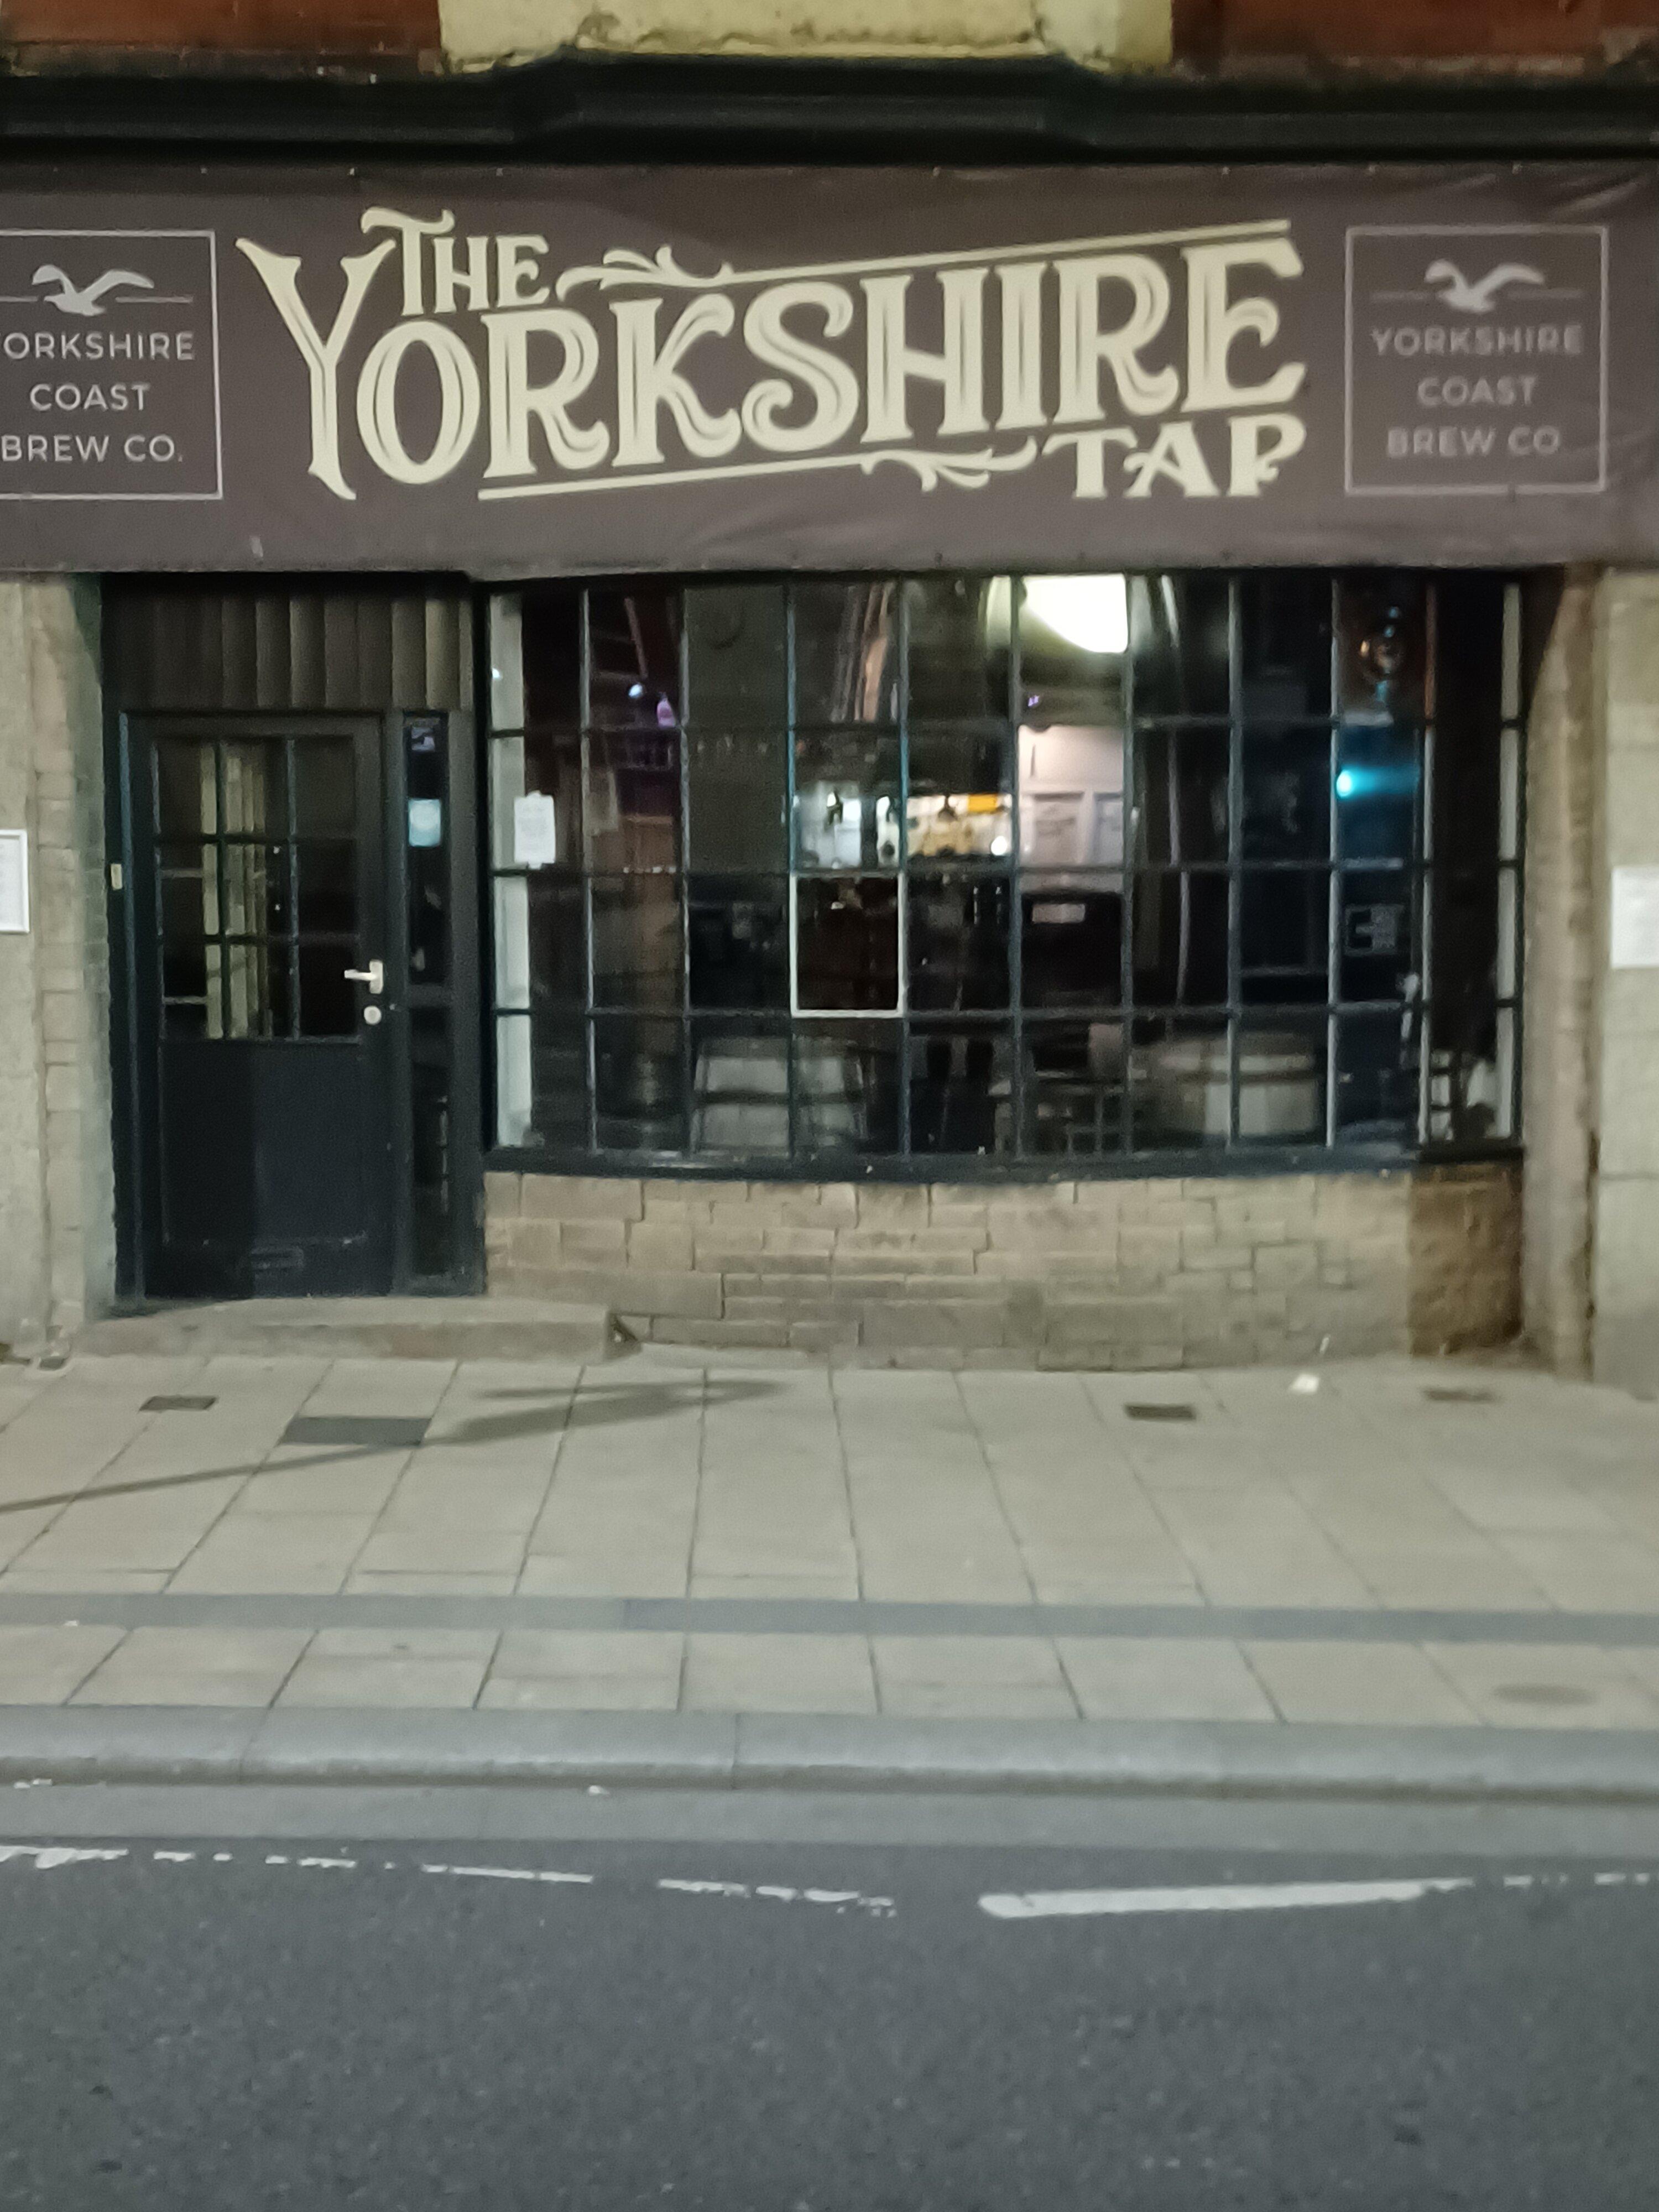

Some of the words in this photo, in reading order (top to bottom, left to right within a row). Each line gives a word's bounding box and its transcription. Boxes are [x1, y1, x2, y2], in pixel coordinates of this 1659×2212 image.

[361, 207, 551, 316] THE
[2, 332, 195, 359] ORKSHIRE
[1369, 324, 1584, 357] YORKSHIRE
[234, 237, 1306, 501] YORKSHIRE
[29, 383, 151, 411] COAST
[1416, 375, 1540, 406] COAST
[1, 434, 109, 462] BREW
[124, 434, 183, 462] CO.
[1041, 412, 1307, 498] TAP
[1387, 426, 1496, 458] BREW
